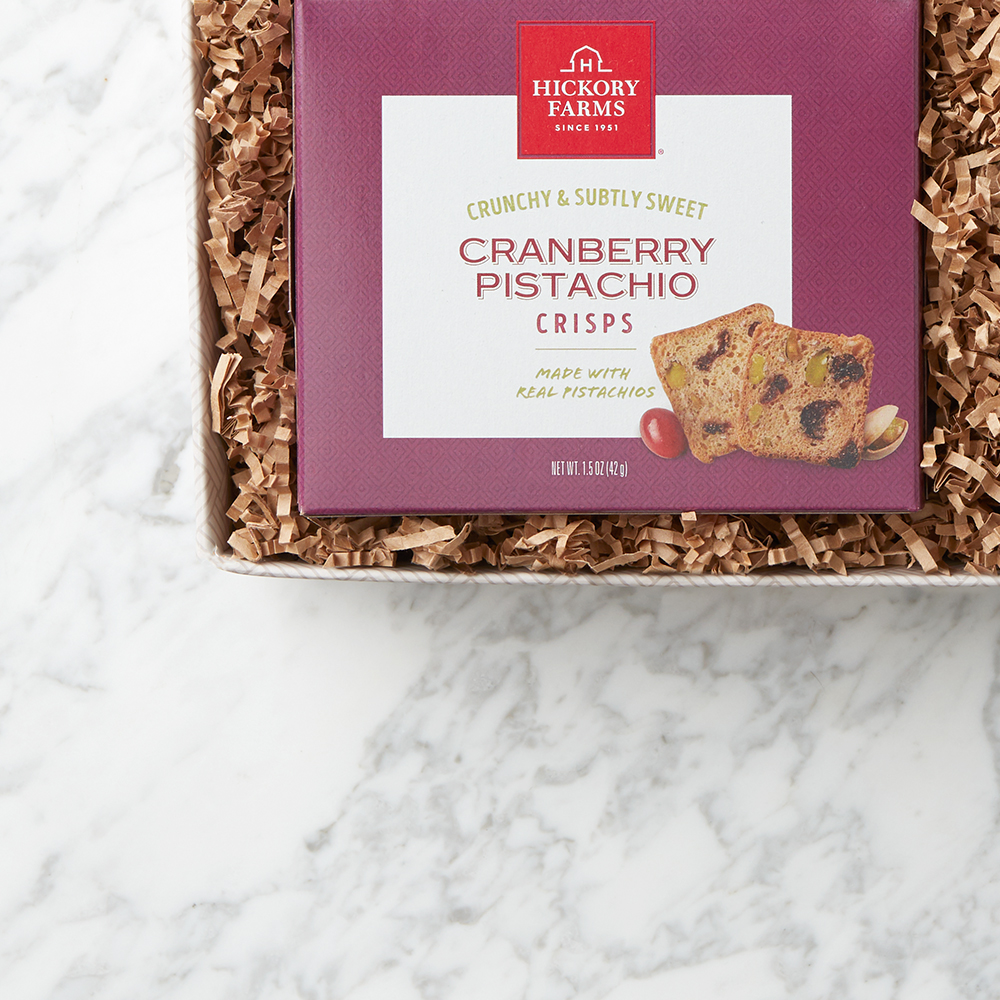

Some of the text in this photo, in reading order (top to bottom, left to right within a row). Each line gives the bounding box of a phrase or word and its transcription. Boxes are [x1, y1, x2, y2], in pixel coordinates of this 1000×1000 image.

[533, 80, 640, 96] HICKORY
[548, 101, 625, 116] FARMS
[467, 188, 708, 220] CRUNCHY & SUBTLY SWEET
[459, 237, 717, 265] CRANBERRY
[476, 272, 699, 300] PISTACHIO
[537, 313, 634, 334] CRISPS
[535, 367, 631, 381] MADE WITH
[516, 387, 656, 399] REAL PISTACHIOS
[551, 461, 628, 477] NET WT. 1.5 OZ (42 g)
